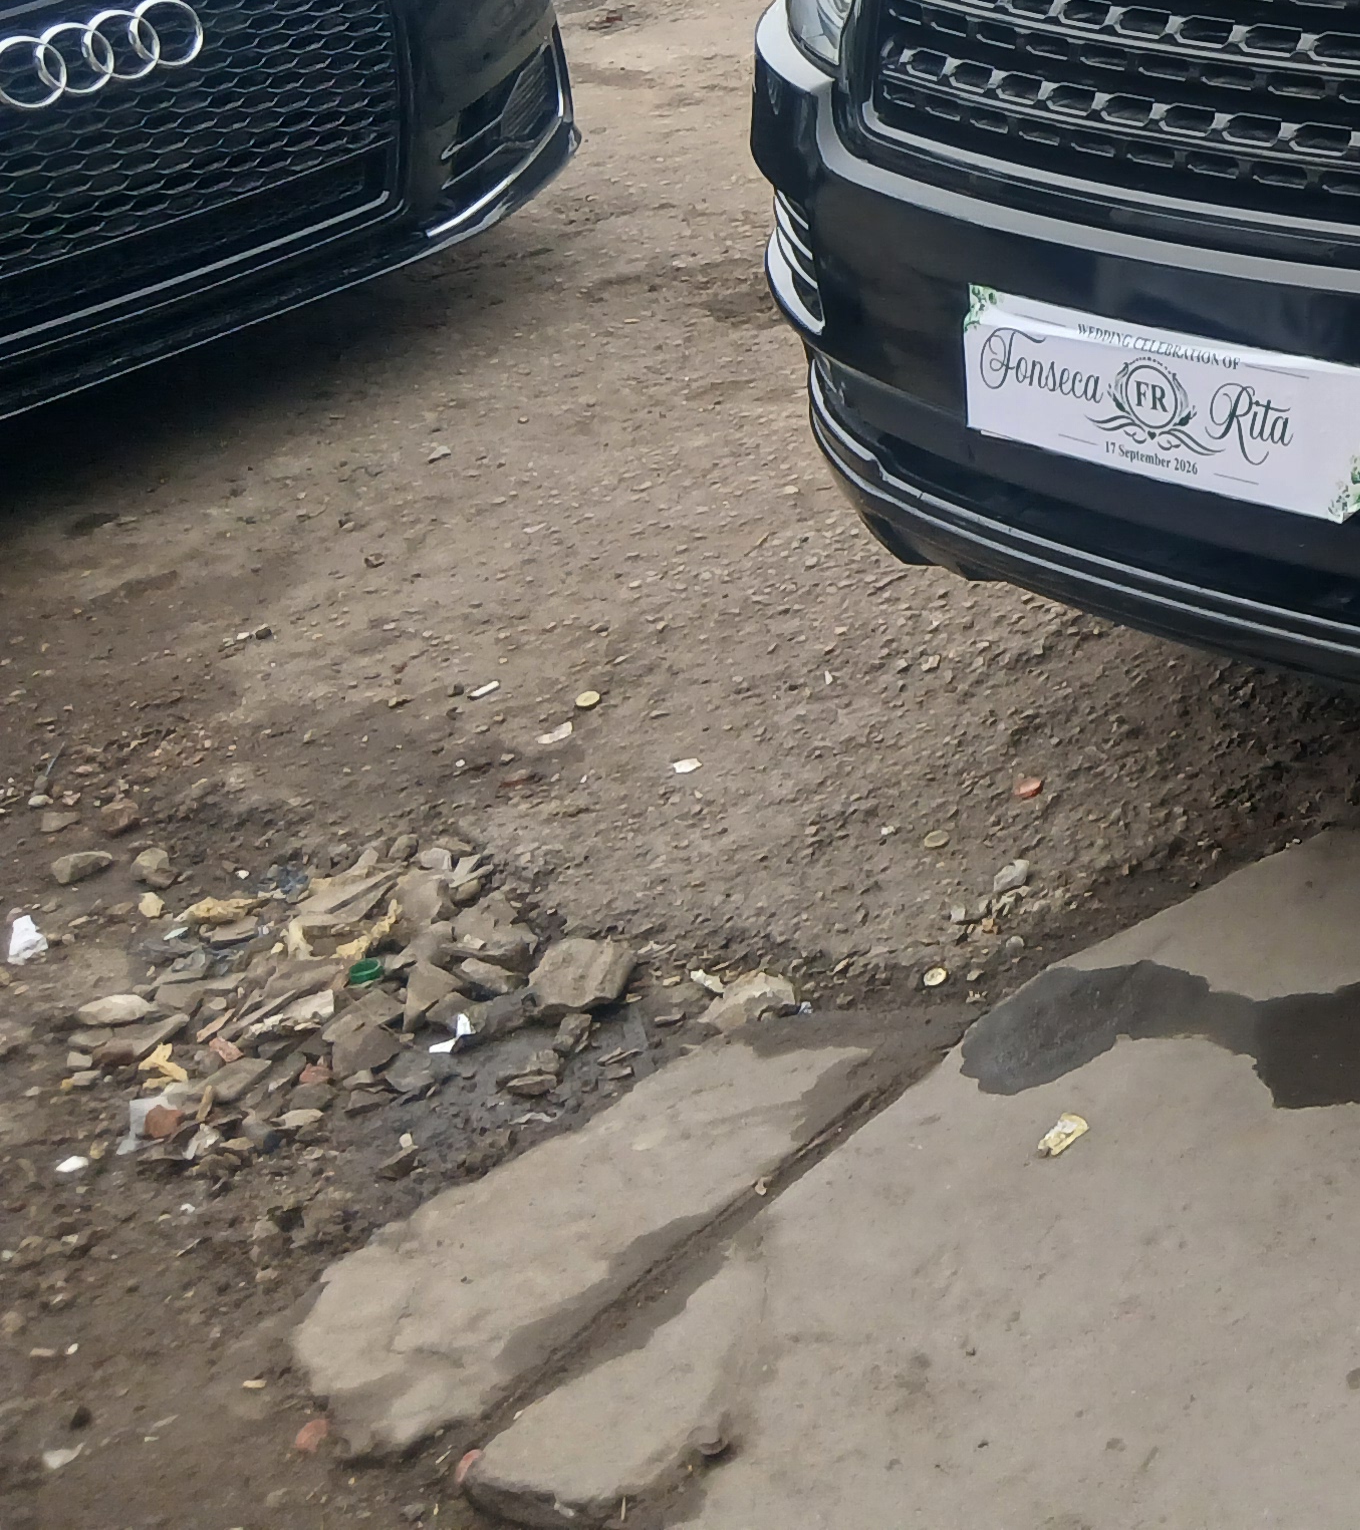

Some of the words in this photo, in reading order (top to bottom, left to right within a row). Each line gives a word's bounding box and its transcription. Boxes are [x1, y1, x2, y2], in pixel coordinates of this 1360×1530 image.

[980, 327, 1104, 404] Fonseca
[1077, 323, 1132, 348] WEDDING
[1133, 336, 1219, 367] CELEBRATION
[1222, 355, 1241, 370] OF
[1135, 379, 1169, 413] FR
[1205, 382, 1294, 466] Rita
[1105, 441, 1116, 454] 17
[1118, 444, 1171, 468] September
[1174, 457, 1198, 475] 2026
